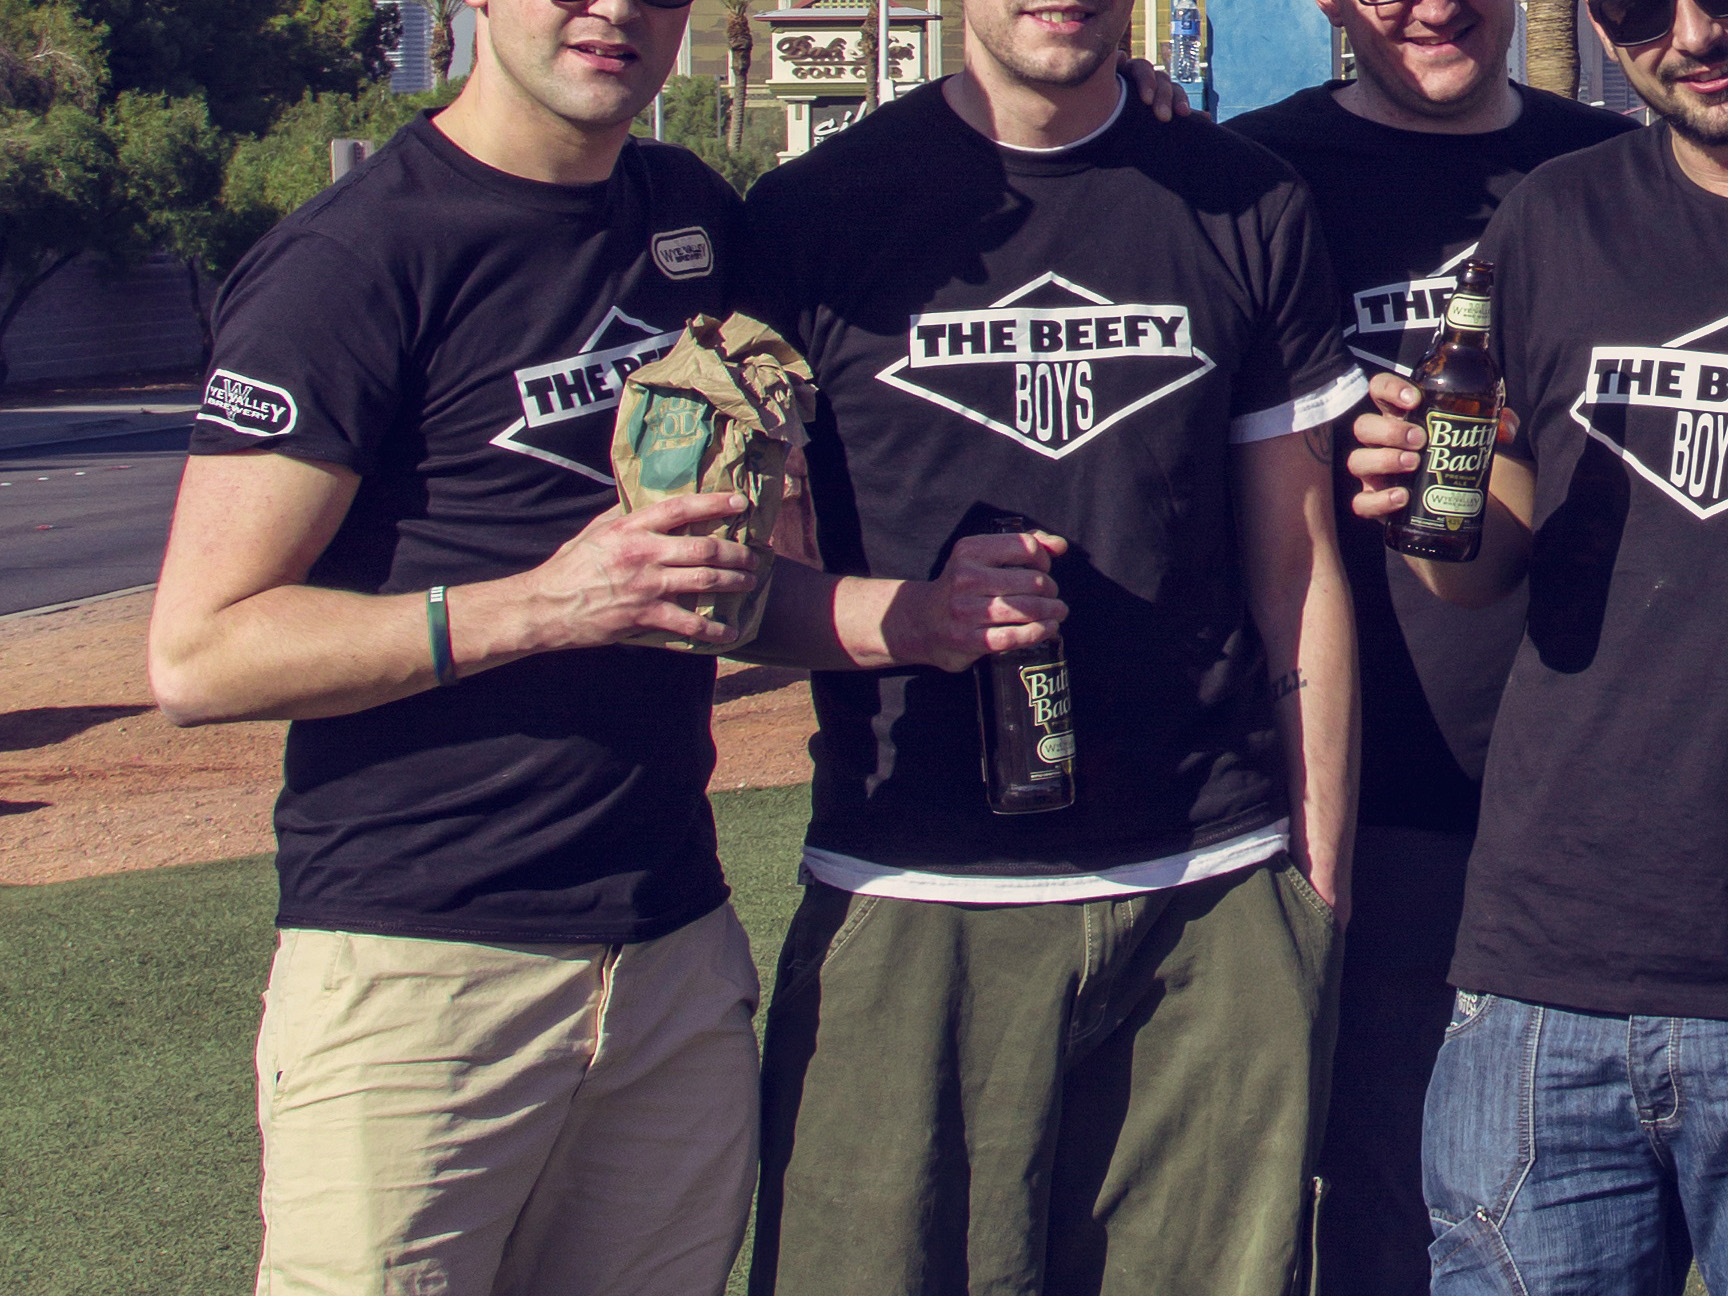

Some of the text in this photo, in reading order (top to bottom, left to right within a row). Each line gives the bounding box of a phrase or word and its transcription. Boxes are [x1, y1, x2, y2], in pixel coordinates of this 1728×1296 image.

[791, 66, 846, 79] GOLF
[916, 315, 1184, 358] THE BEEFY
[523, 364, 616, 416] THE
[1594, 359, 1686, 399] THE
[1015, 360, 1094, 442] BOYS
[1430, 420, 1498, 454] Butty
[1428, 446, 1492, 473] Bach
